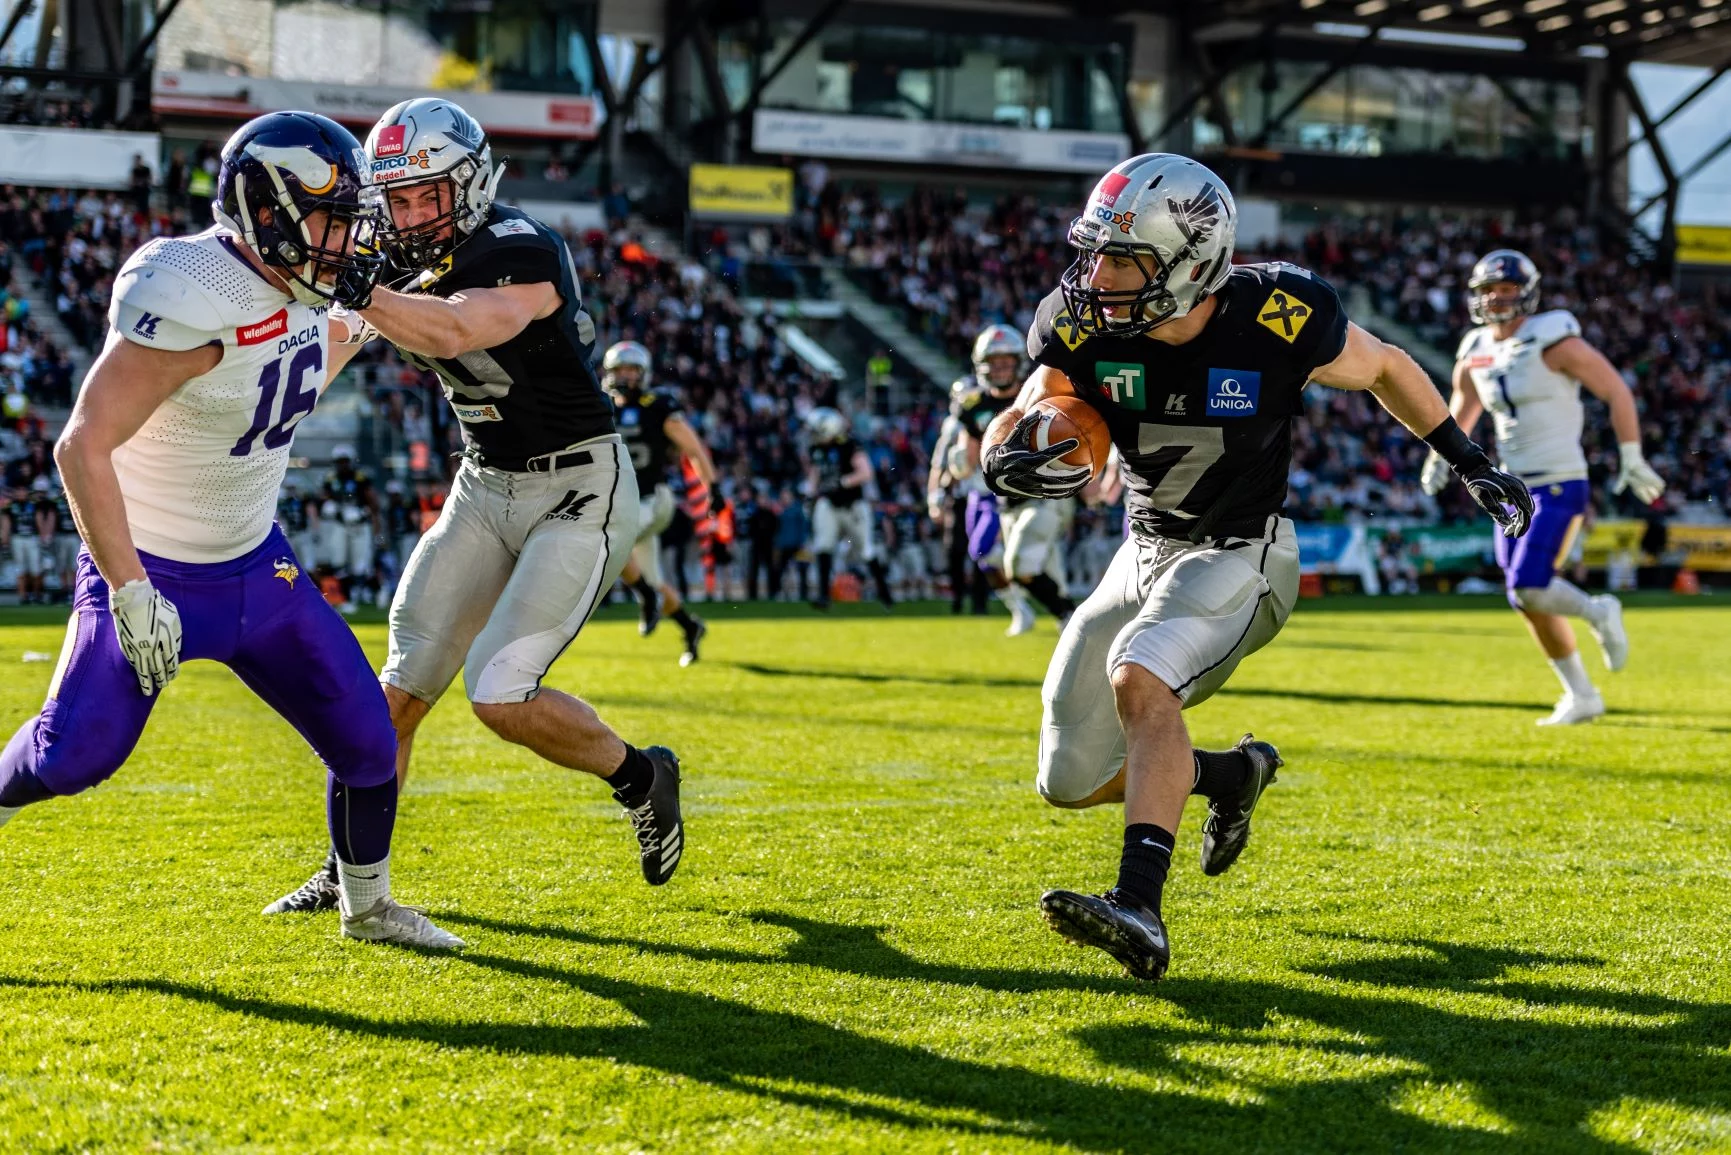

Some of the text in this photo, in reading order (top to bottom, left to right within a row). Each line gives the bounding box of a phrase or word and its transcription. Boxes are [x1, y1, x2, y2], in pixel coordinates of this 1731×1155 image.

[375, 169, 406, 182] Riddell
[278, 325, 319, 355] DACIA
[229, 342, 323, 457] 16
[1210, 398, 1254, 410] UNIQA
[1137, 422, 1225, 518] 7
